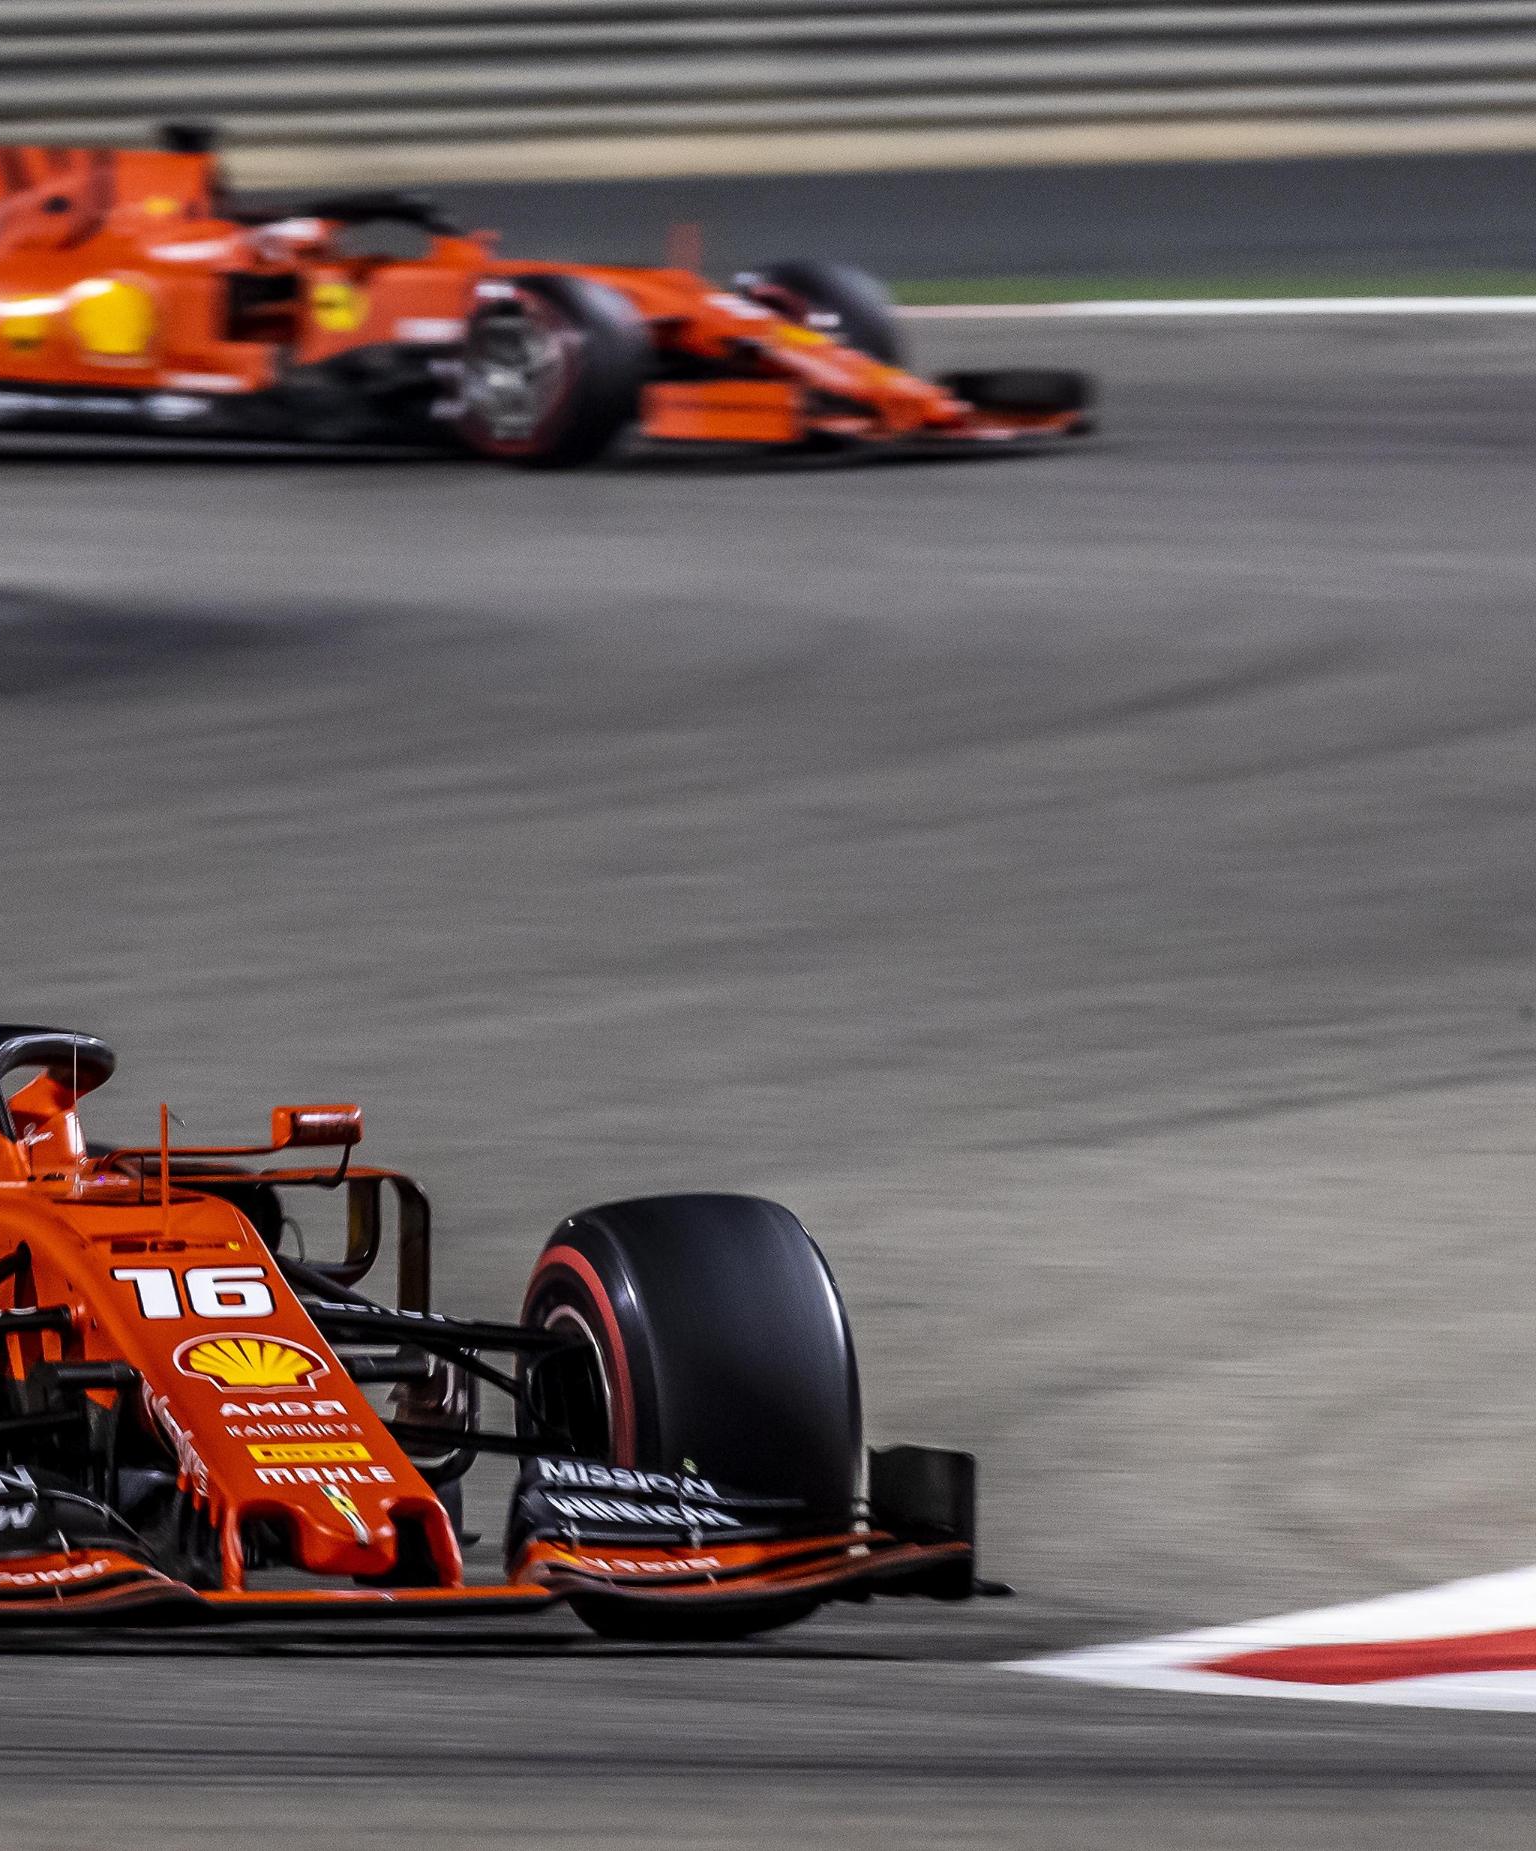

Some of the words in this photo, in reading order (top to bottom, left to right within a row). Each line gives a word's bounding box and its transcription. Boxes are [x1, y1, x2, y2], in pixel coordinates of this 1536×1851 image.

[111, 1267, 276, 1319] 16
[224, 1421, 350, 1439] KASPERSKY
[254, 1465, 396, 1485] MAHLE
[536, 1456, 726, 1504] MISSION
